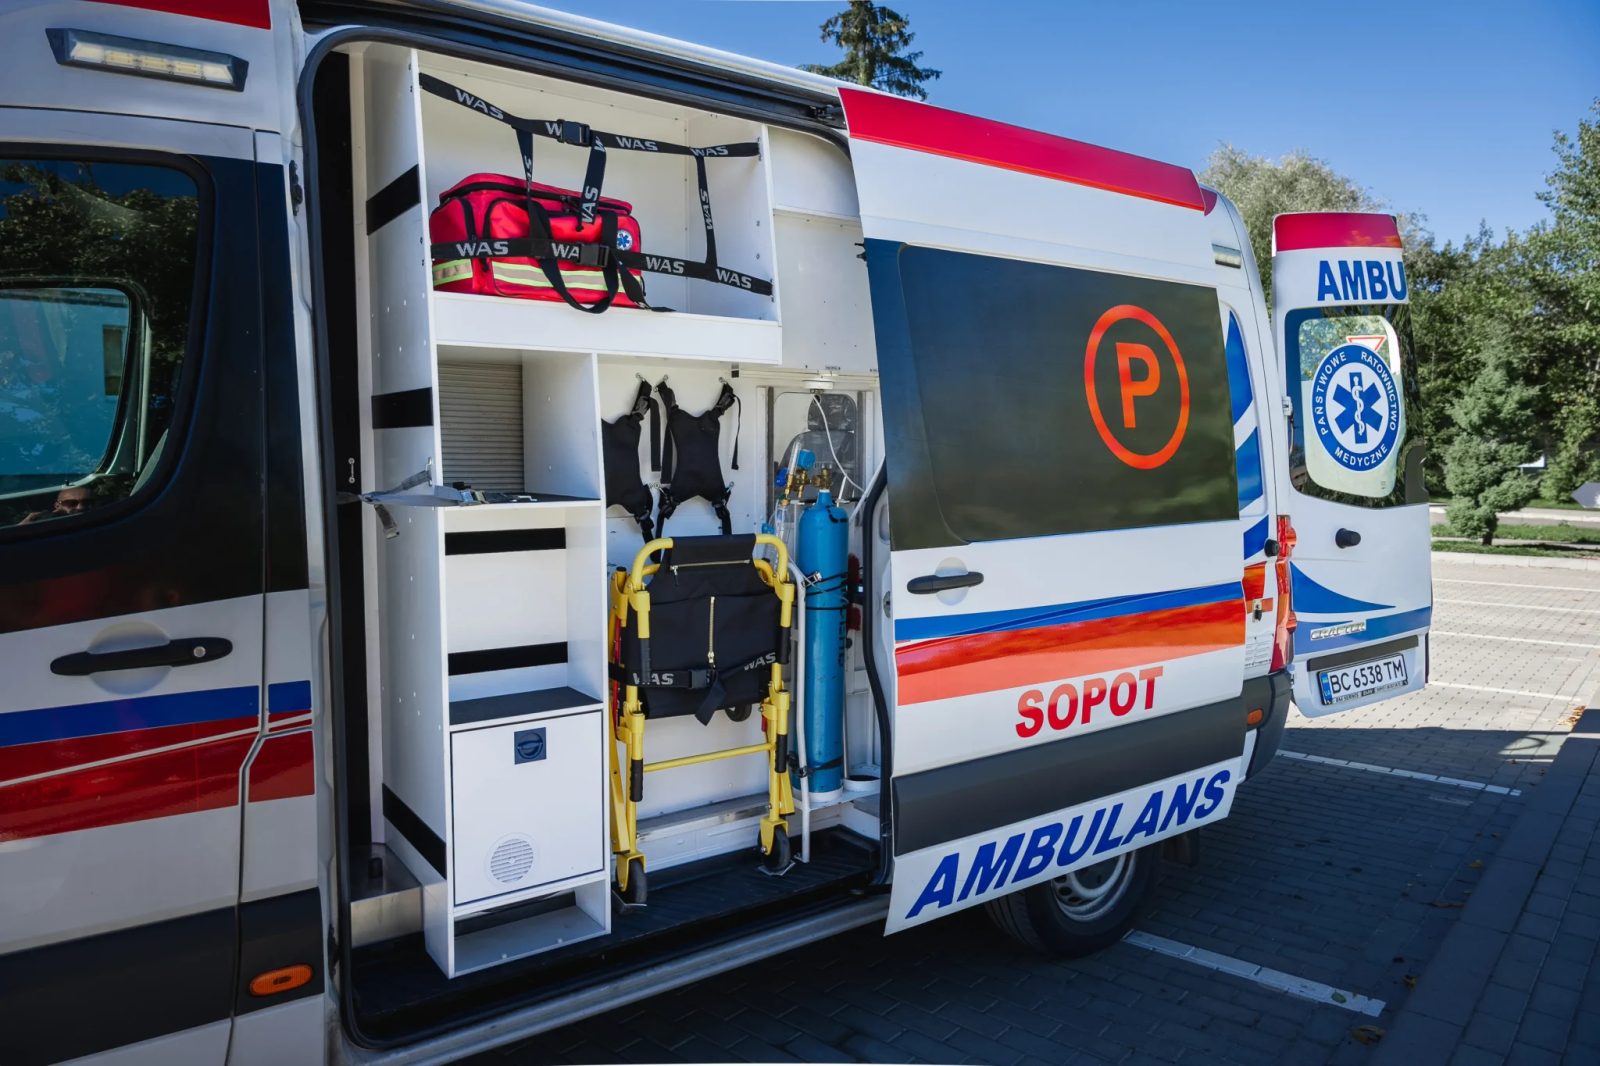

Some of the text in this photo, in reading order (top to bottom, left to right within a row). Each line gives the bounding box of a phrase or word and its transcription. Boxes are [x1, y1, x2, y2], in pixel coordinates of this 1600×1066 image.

[455, 88, 504, 120] WAS
[616, 136, 658, 151] WAS
[690, 146, 729, 157] WAS
[700, 188, 713, 230] WAS
[456, 241, 509, 257] WAS
[551, 242, 580, 259] WA
[645, 256, 685, 275] WAS
[716, 268, 752, 289] WAS
[1317, 260, 1407, 301] AMBU
[1115, 342, 1161, 428] P
[1360, 351, 1398, 431] RATOWNICTWO
[1334, 443, 1388, 467] MEDYCZNE
[743, 652, 777, 671] WAS
[1330, 672, 1351, 694] BC
[1353, 664, 1383, 689] 6538
[1383, 659, 1404, 681] TM
[1015, 666, 1163, 738] SOPOT
[905, 769, 1231, 919] AMBULANS
